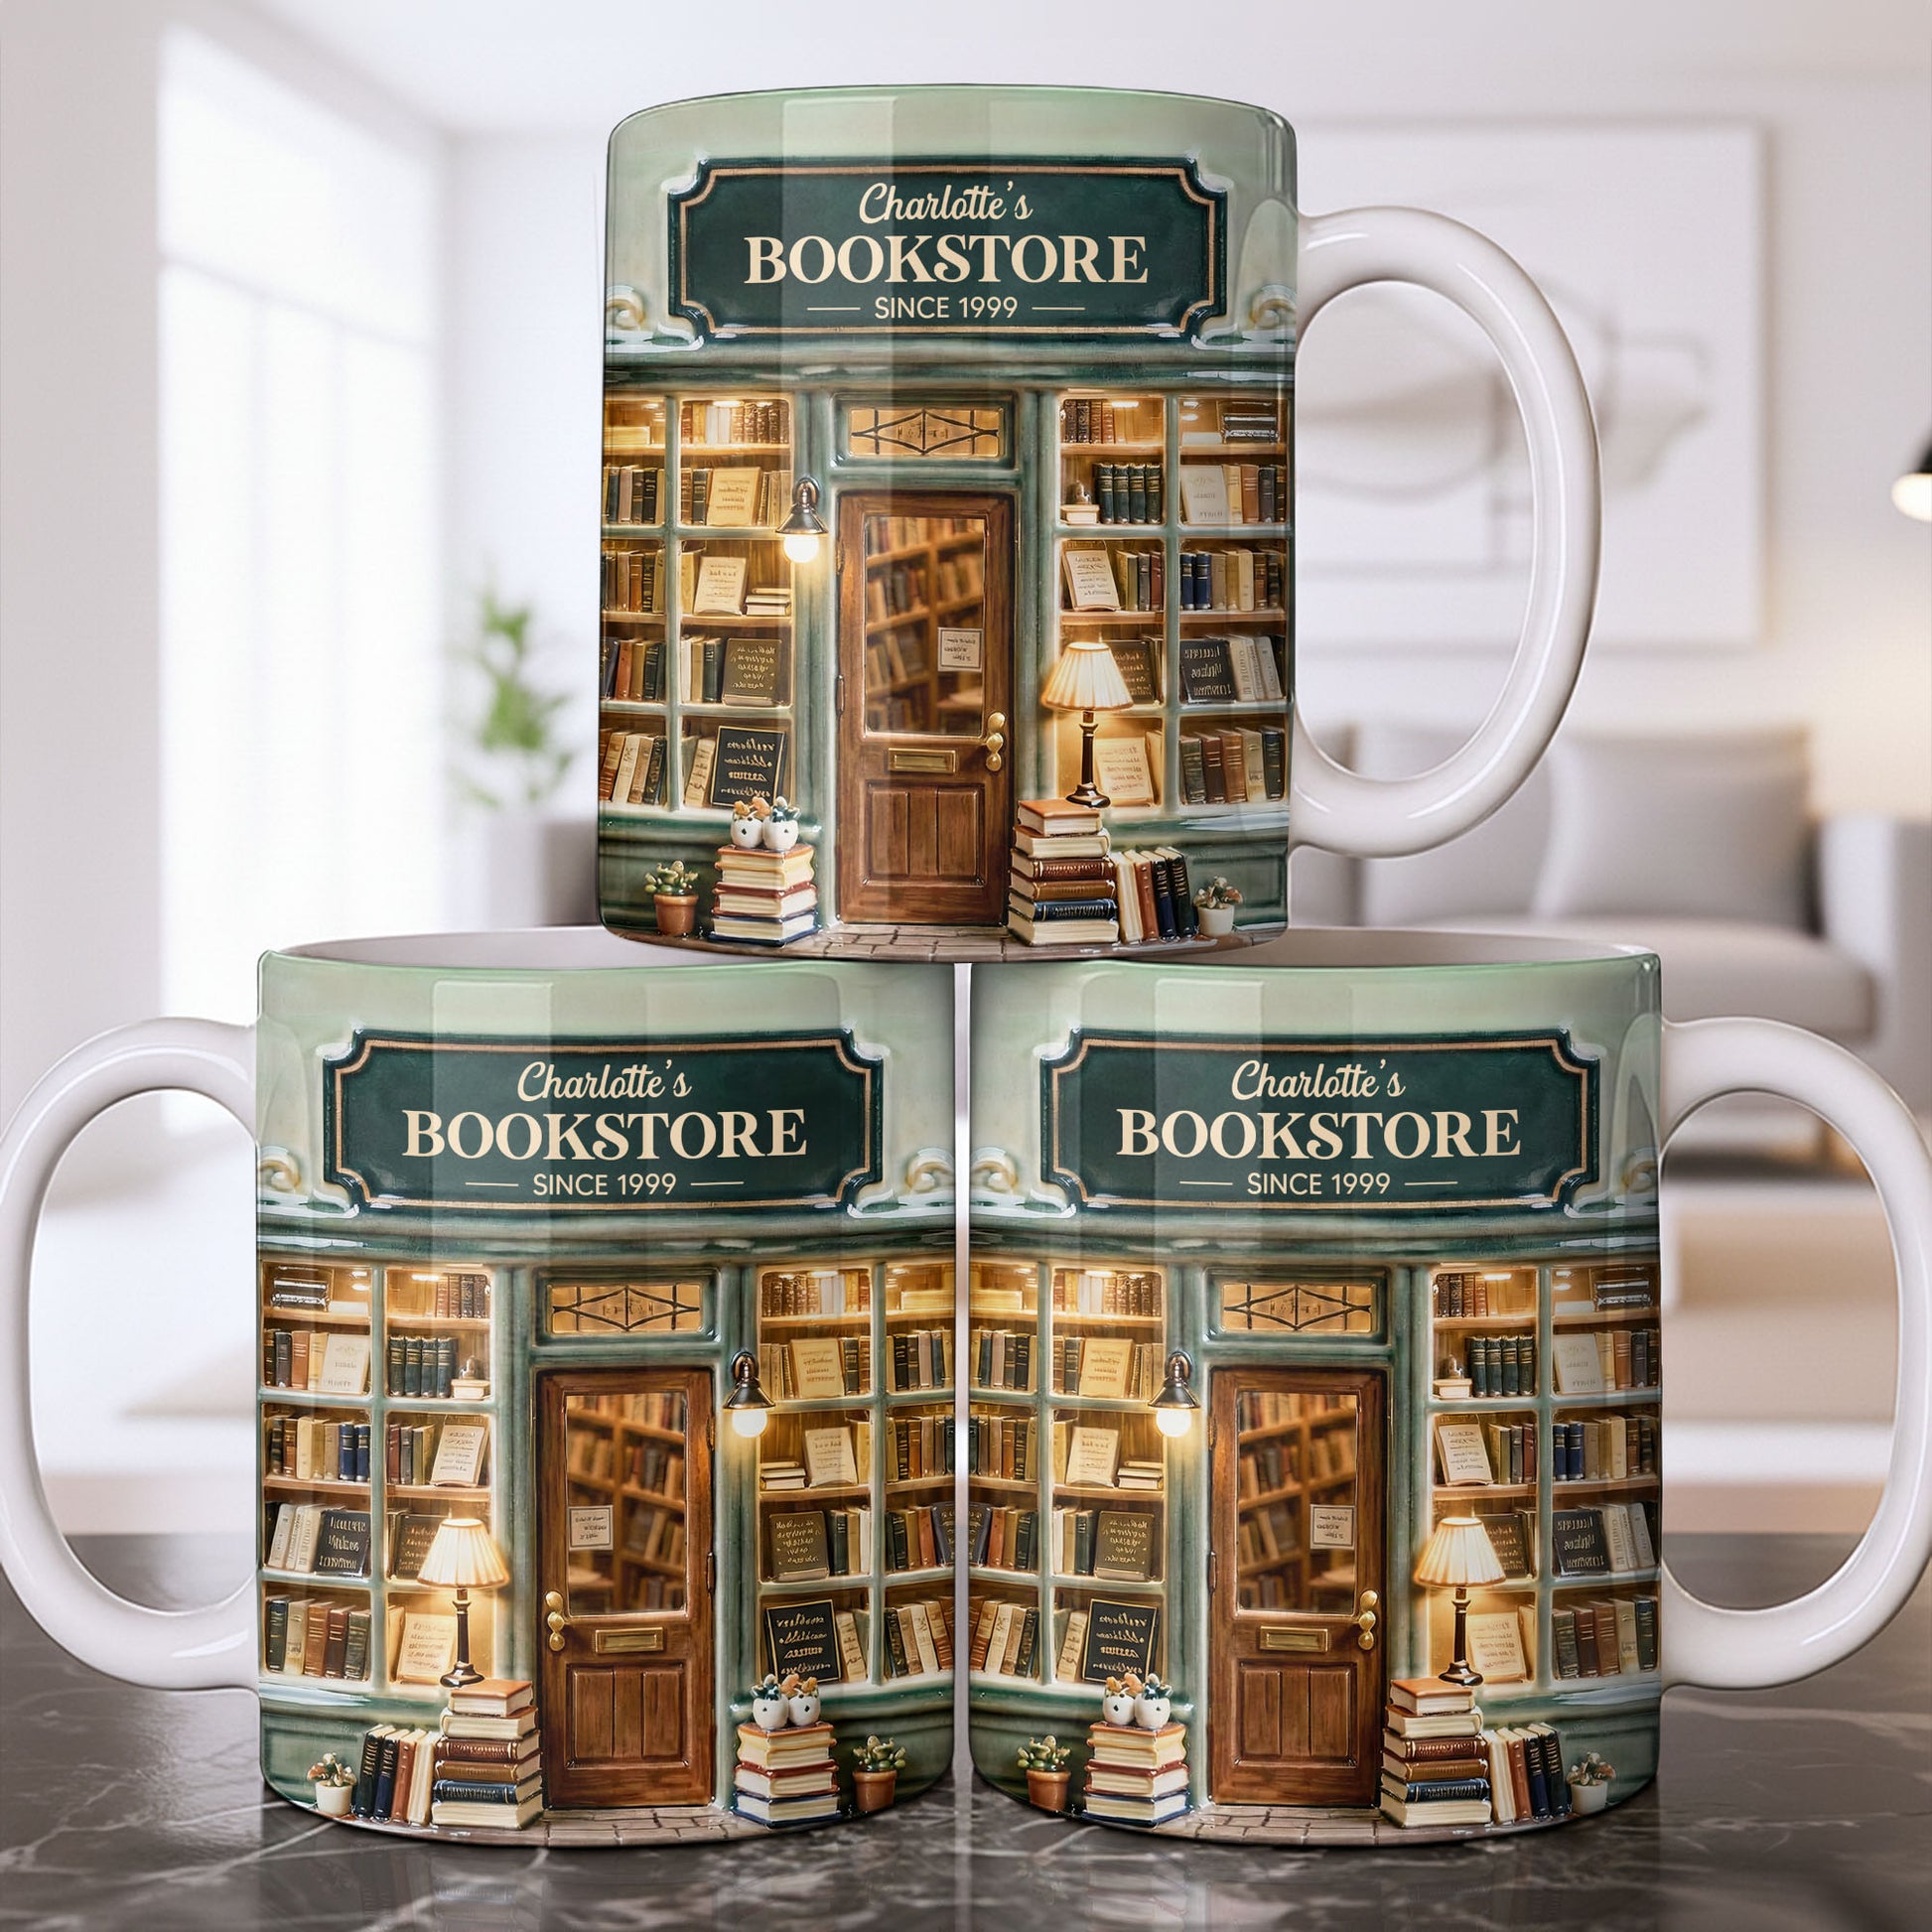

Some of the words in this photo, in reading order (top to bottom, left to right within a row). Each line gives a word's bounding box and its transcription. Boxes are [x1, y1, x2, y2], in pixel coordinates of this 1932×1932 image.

[859, 181, 1034, 224] Charlotte's
[745, 234, 1149, 284] BOOKSTORE
[874, 296, 950, 320] SINCE
[959, 296, 1018, 319] 1999
[517, 1058, 694, 1102] Charlotte's
[1231, 1058, 1407, 1101] Charlotte's
[402, 1109, 807, 1161] BOOKSTORE
[1116, 1108, 1522, 1161] BOOKSTORE
[533, 1173, 609, 1196] SINCE
[619, 1173, 677, 1195] 1999
[1247, 1172, 1322, 1195] SINCE
[1331, 1172, 1391, 1194] 1999
